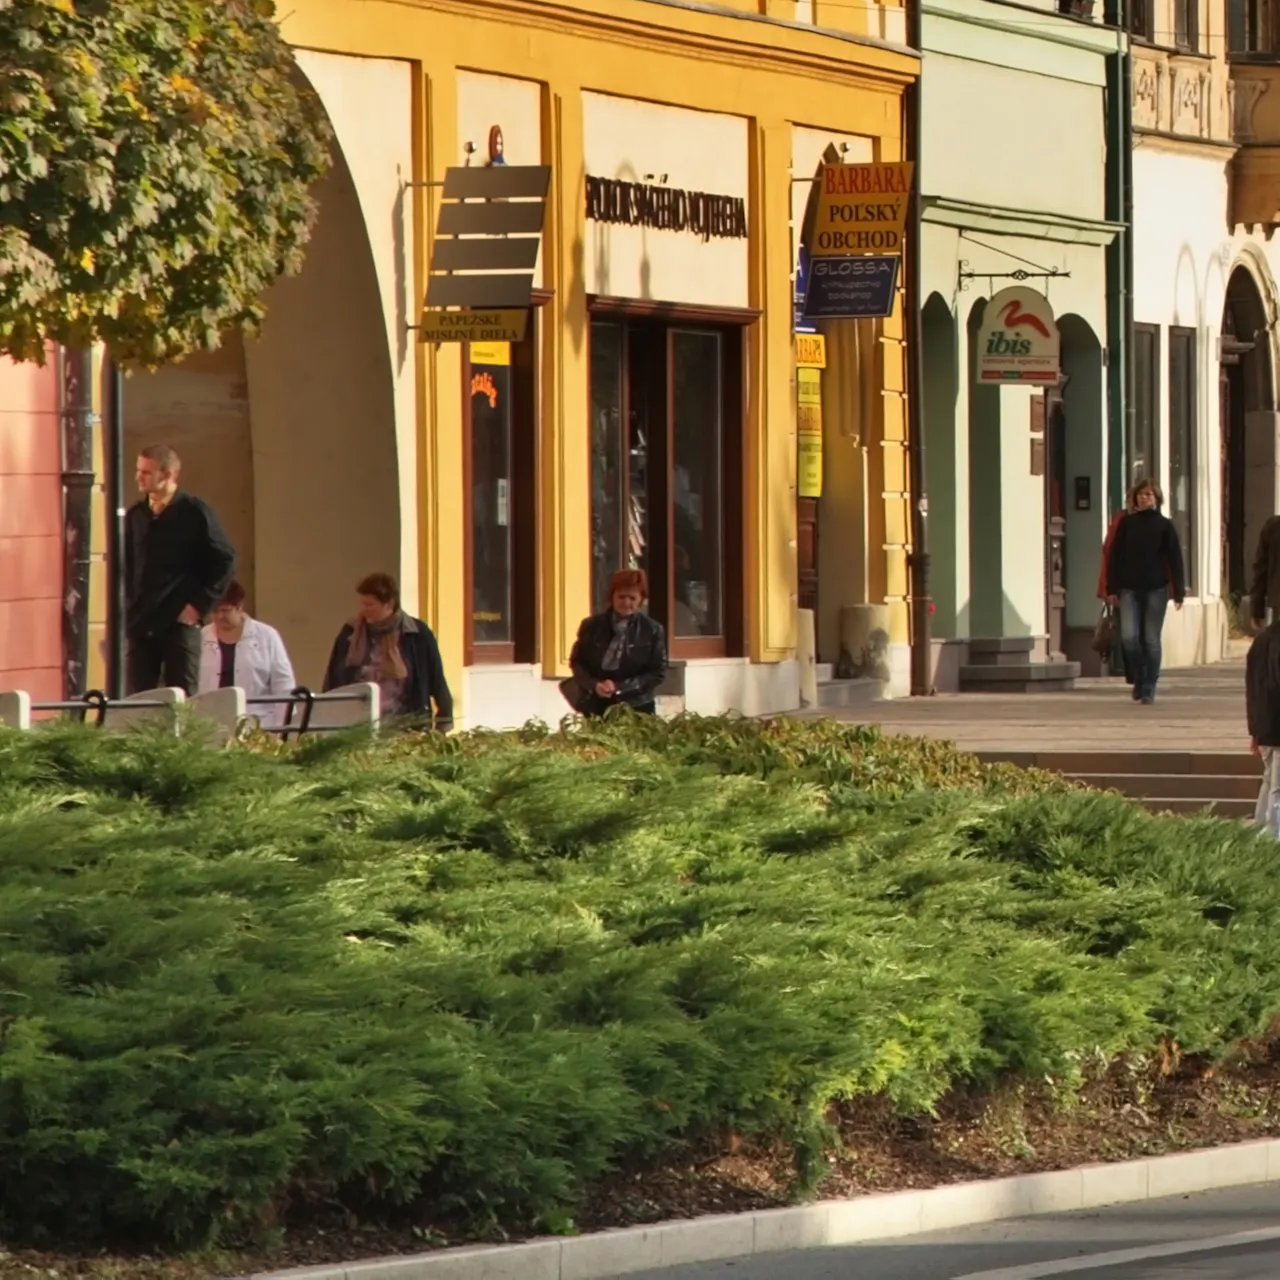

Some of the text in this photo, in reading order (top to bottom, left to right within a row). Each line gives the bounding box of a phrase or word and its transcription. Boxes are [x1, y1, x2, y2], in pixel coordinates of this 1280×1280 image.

[824, 166, 908, 195] BARBARA
[829, 196, 902, 223] POĽSKÝ
[818, 230, 898, 249] OBCHOD
[814, 261, 890, 276] GLOSSA
[480, 328, 518, 340] DIELA
[986, 331, 1032, 355] ibis
